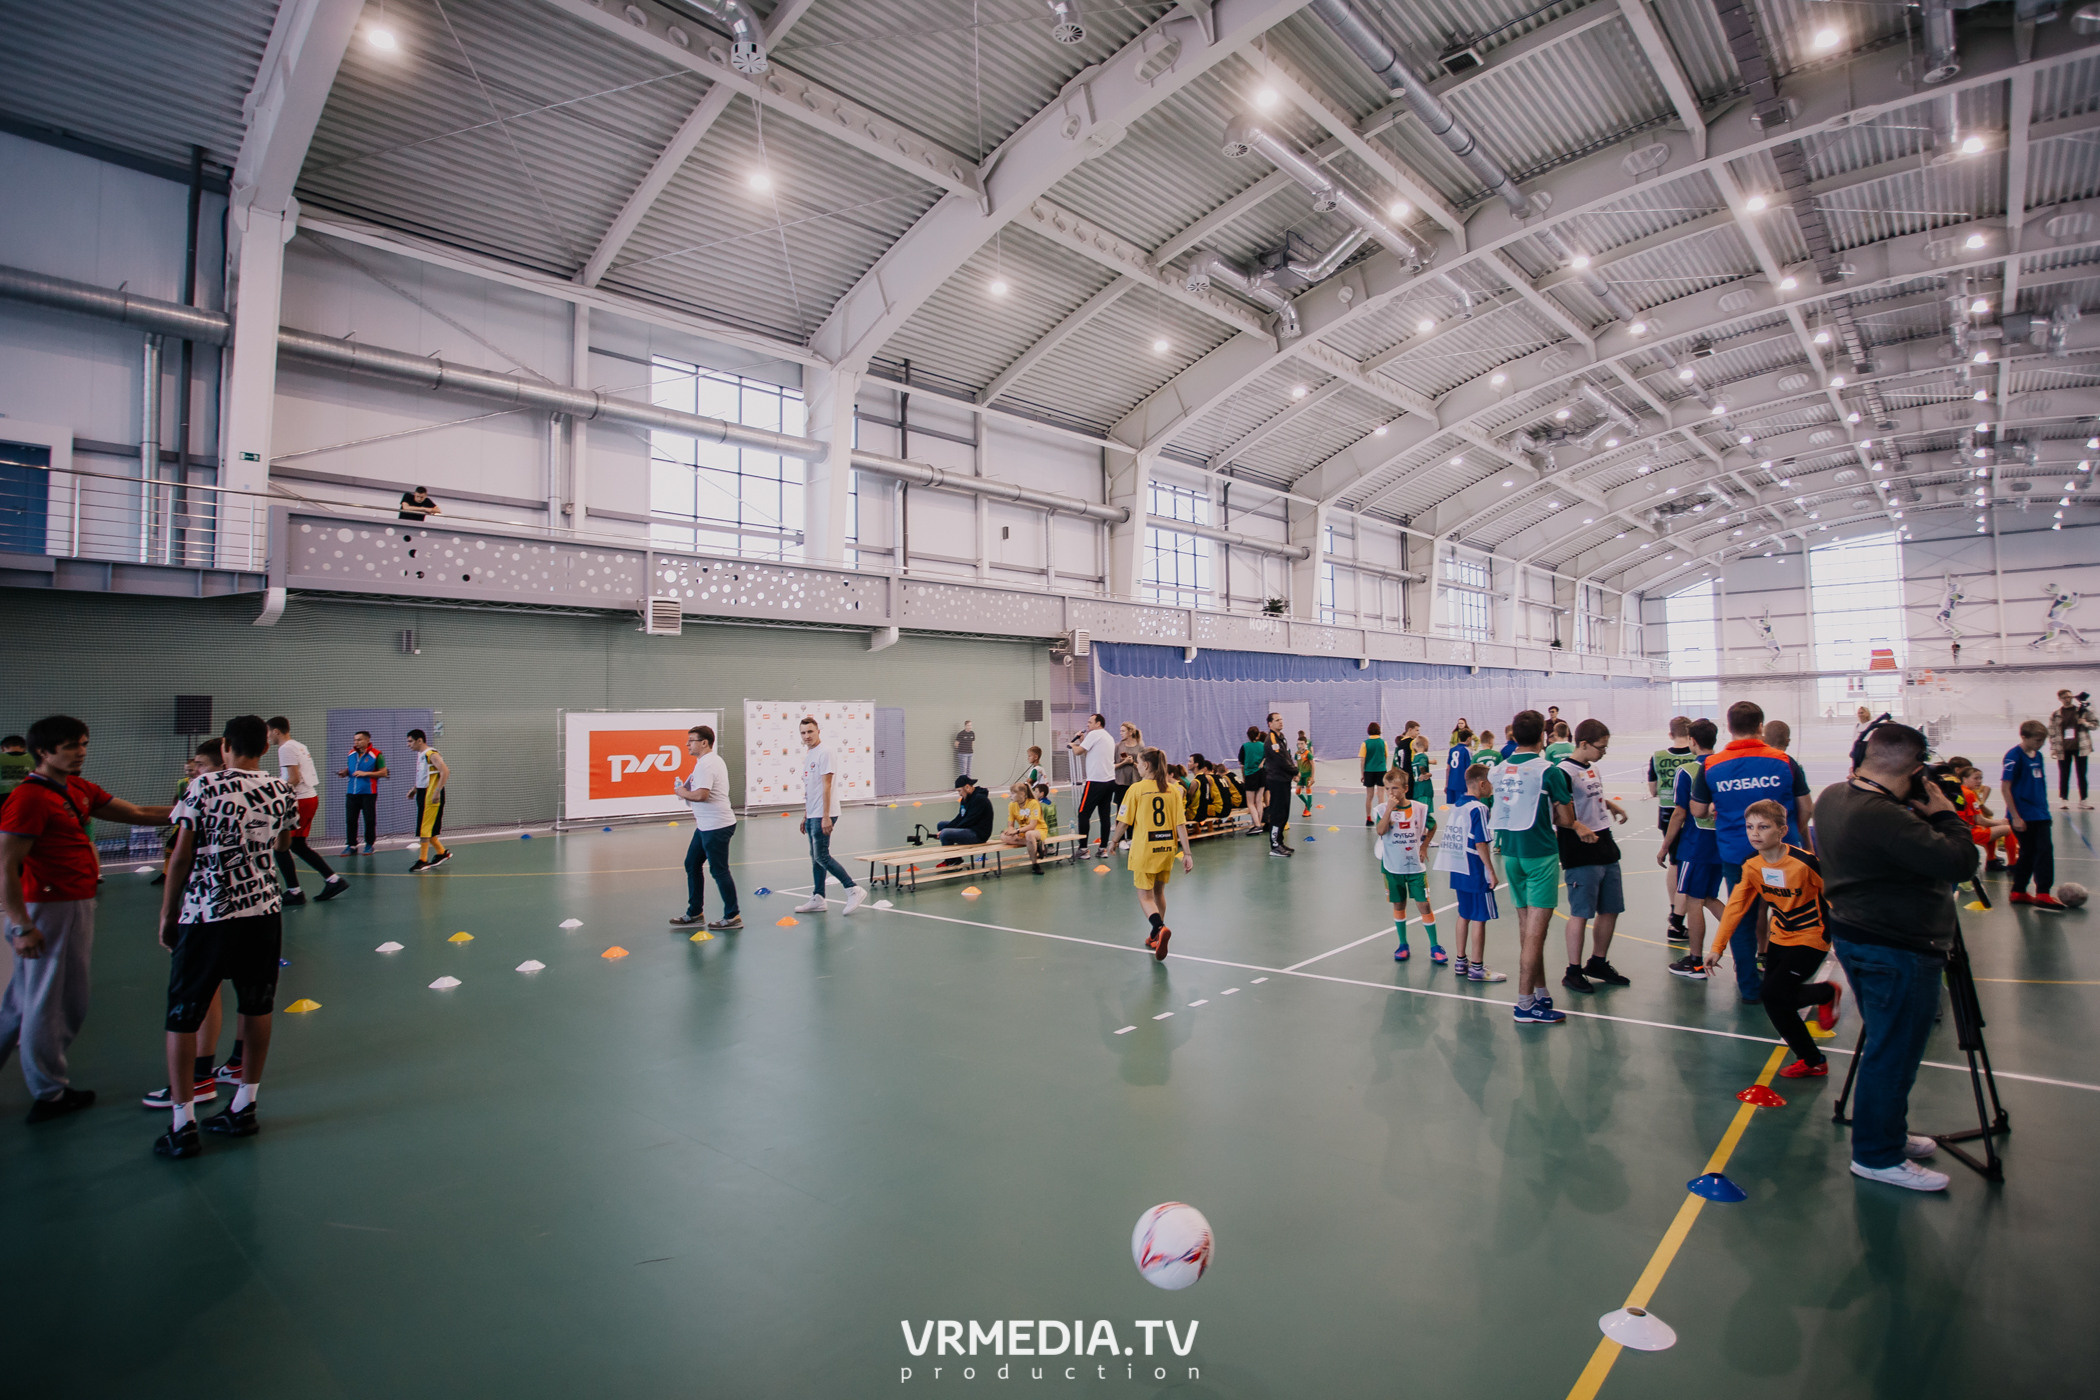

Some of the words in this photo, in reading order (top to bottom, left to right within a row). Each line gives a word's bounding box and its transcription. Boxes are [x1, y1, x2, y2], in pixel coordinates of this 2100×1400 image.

[1450, 751, 1460, 768] 8
[1716, 776, 1781, 792] КУЗБАСС
[1152, 796, 1166, 827] 8
